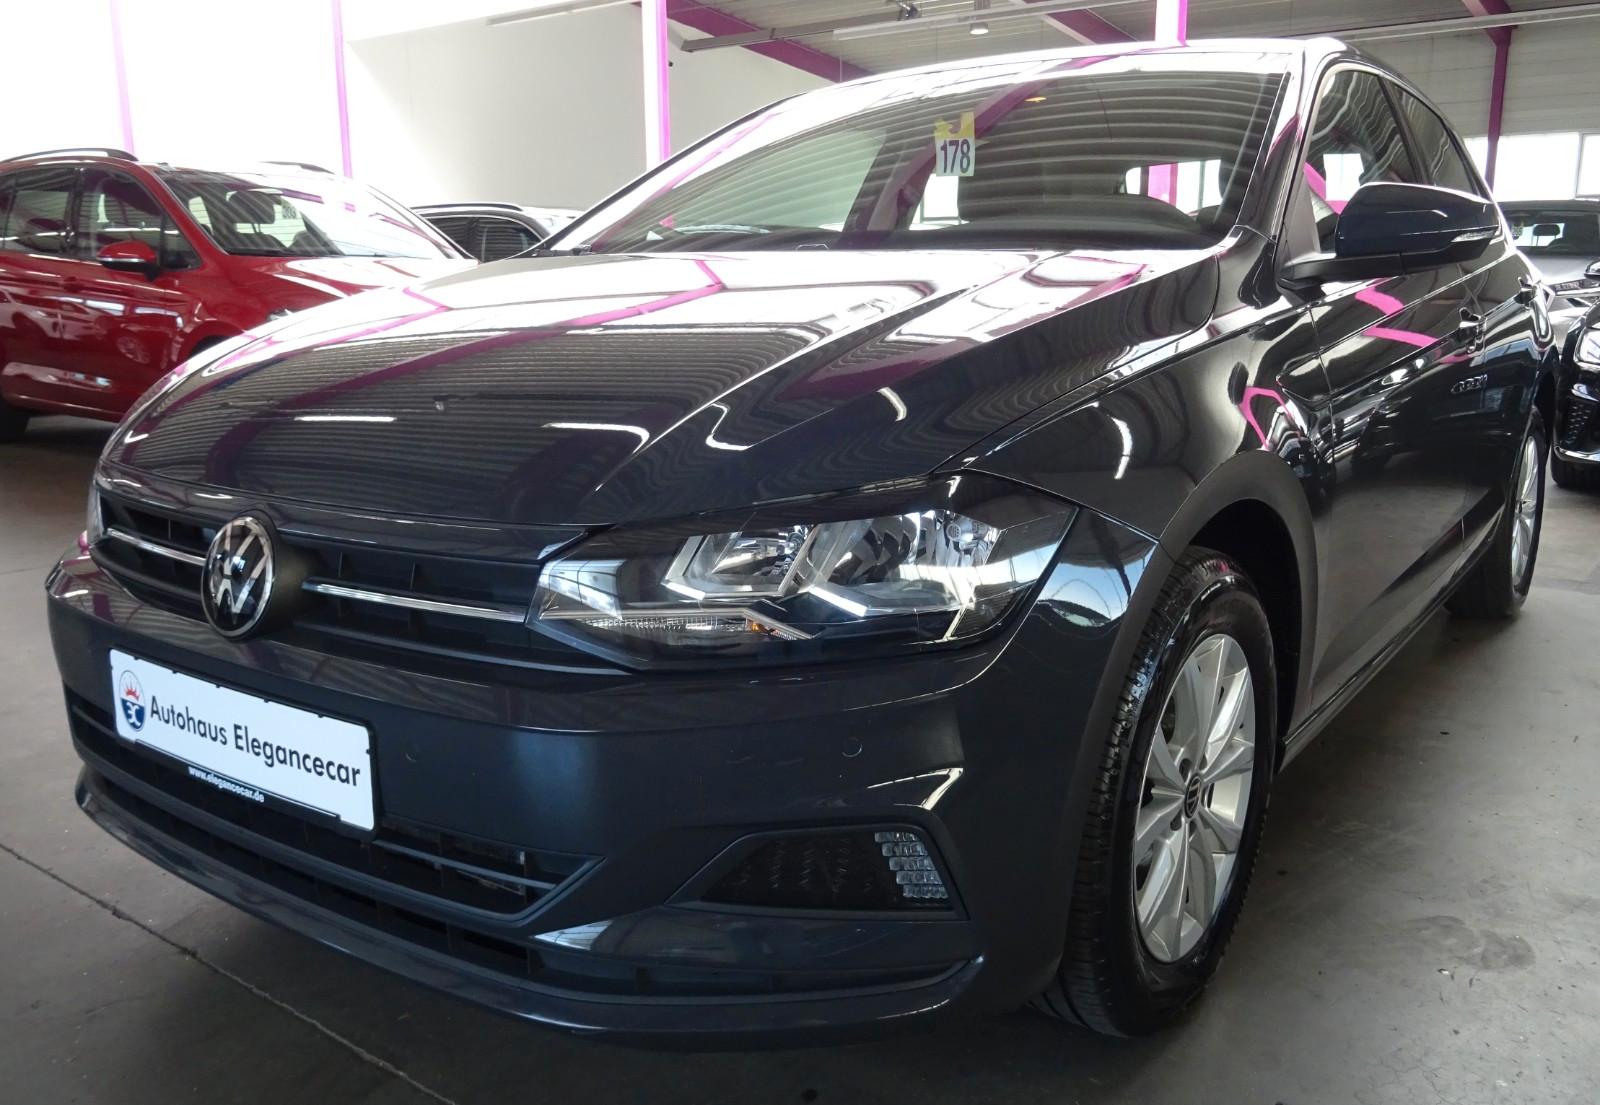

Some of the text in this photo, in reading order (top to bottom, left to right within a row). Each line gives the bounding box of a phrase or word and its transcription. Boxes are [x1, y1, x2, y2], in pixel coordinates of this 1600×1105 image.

[941, 139, 971, 173] 178
[150, 695, 228, 746] Autohaus
[233, 723, 361, 787] Elegancecar
[187, 766, 265, 803] www.elegancecar.de
